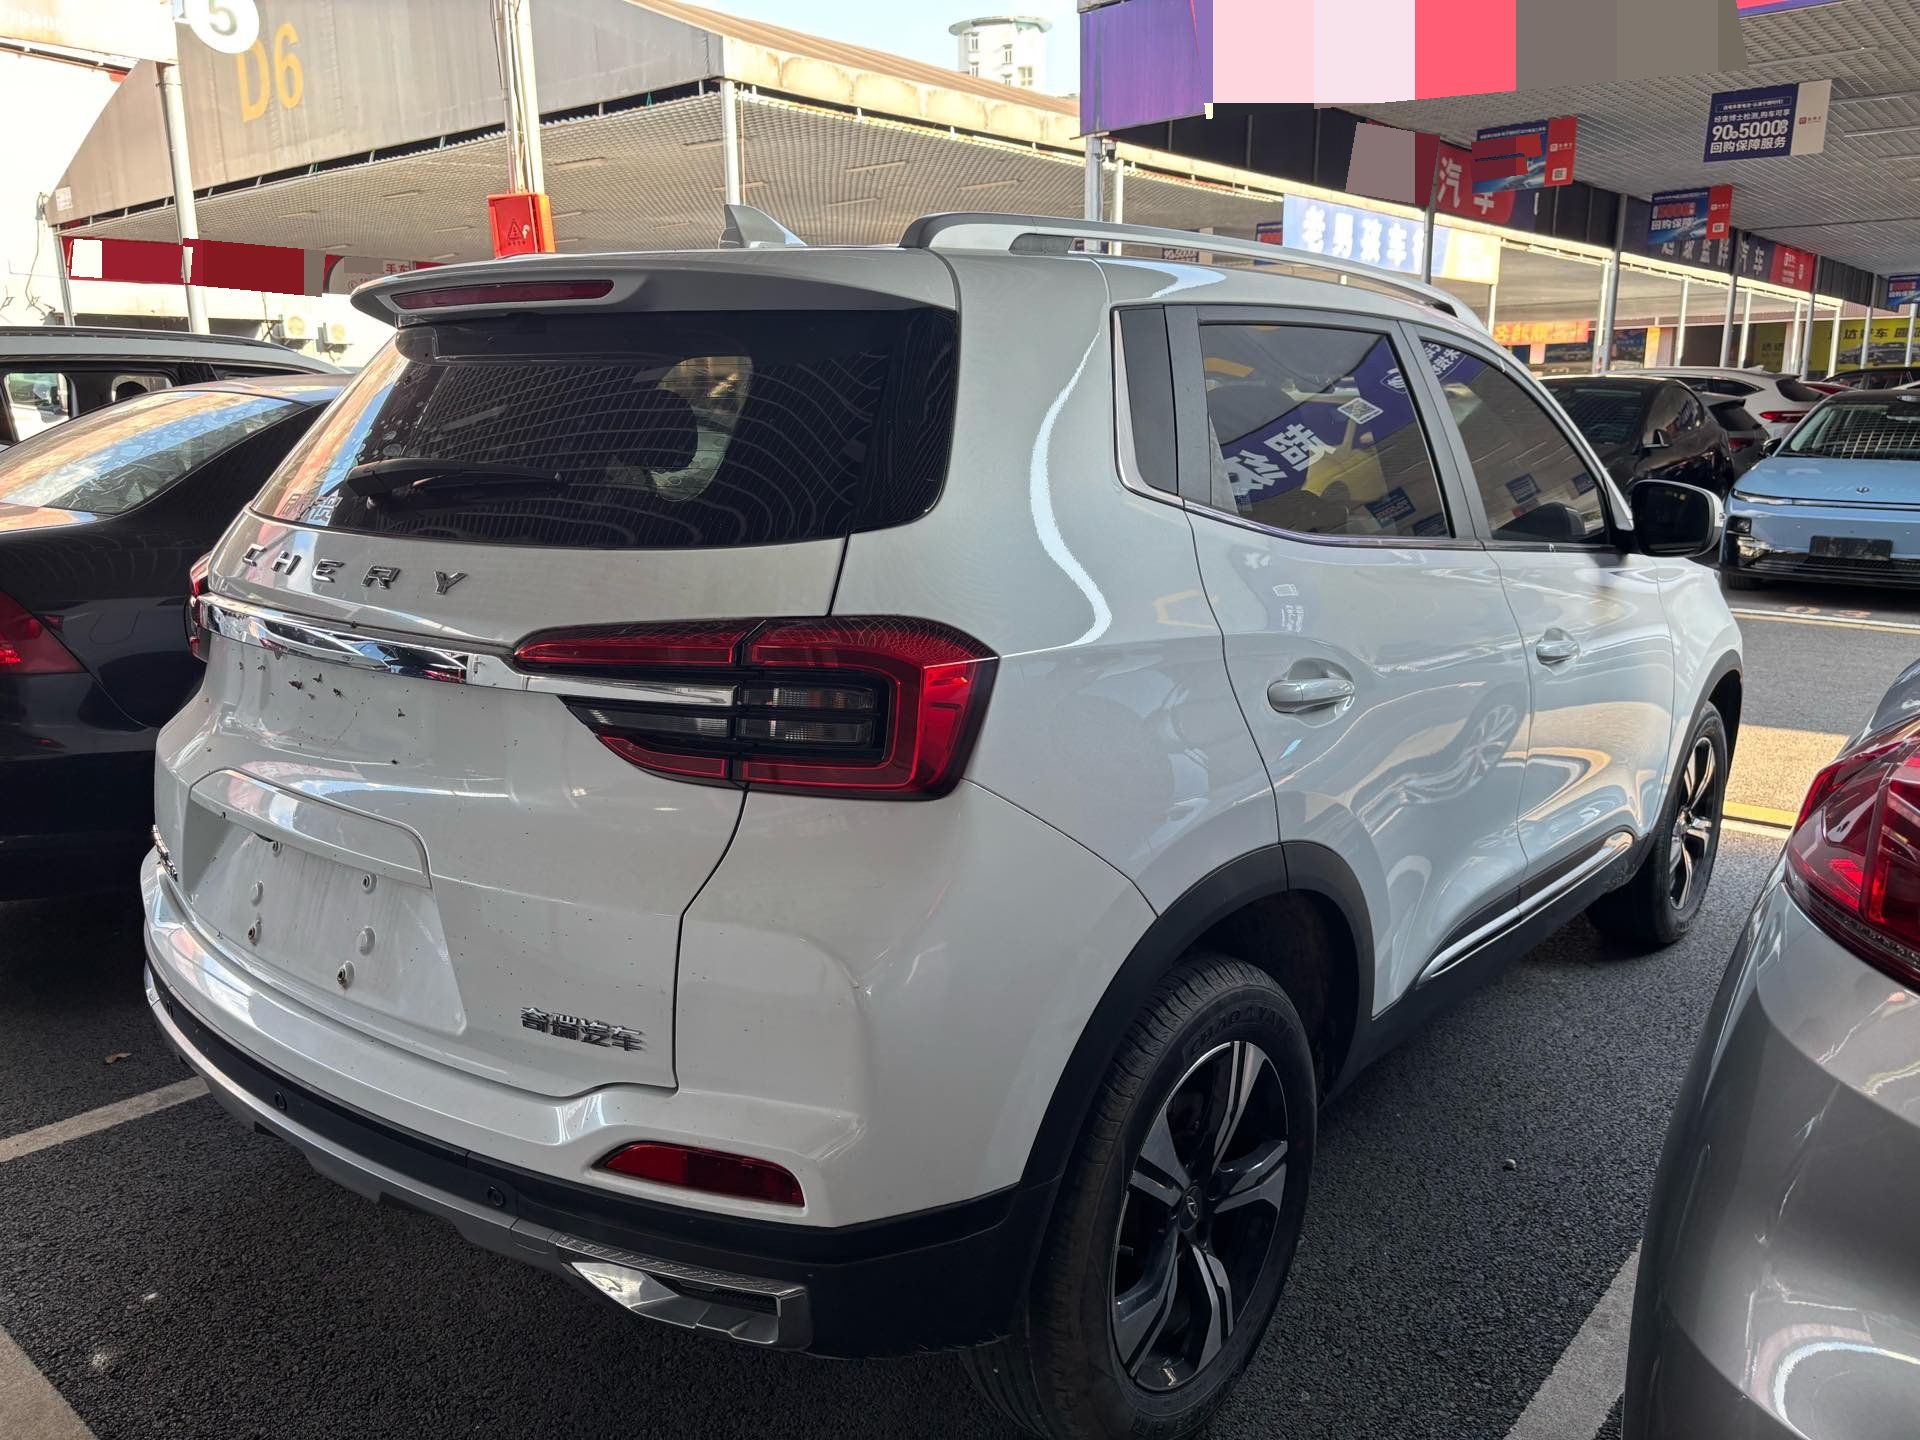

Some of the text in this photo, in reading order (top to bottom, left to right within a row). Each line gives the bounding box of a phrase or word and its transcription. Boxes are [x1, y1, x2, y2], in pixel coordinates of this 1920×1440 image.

[209, 0, 238, 36] 5
[235, 22, 304, 123] D6
[1710, 136, 1787, 154] 回购保障服务
[242, 543, 468, 595] CHERY
[521, 1006, 644, 1051] 奇瑞汽车
